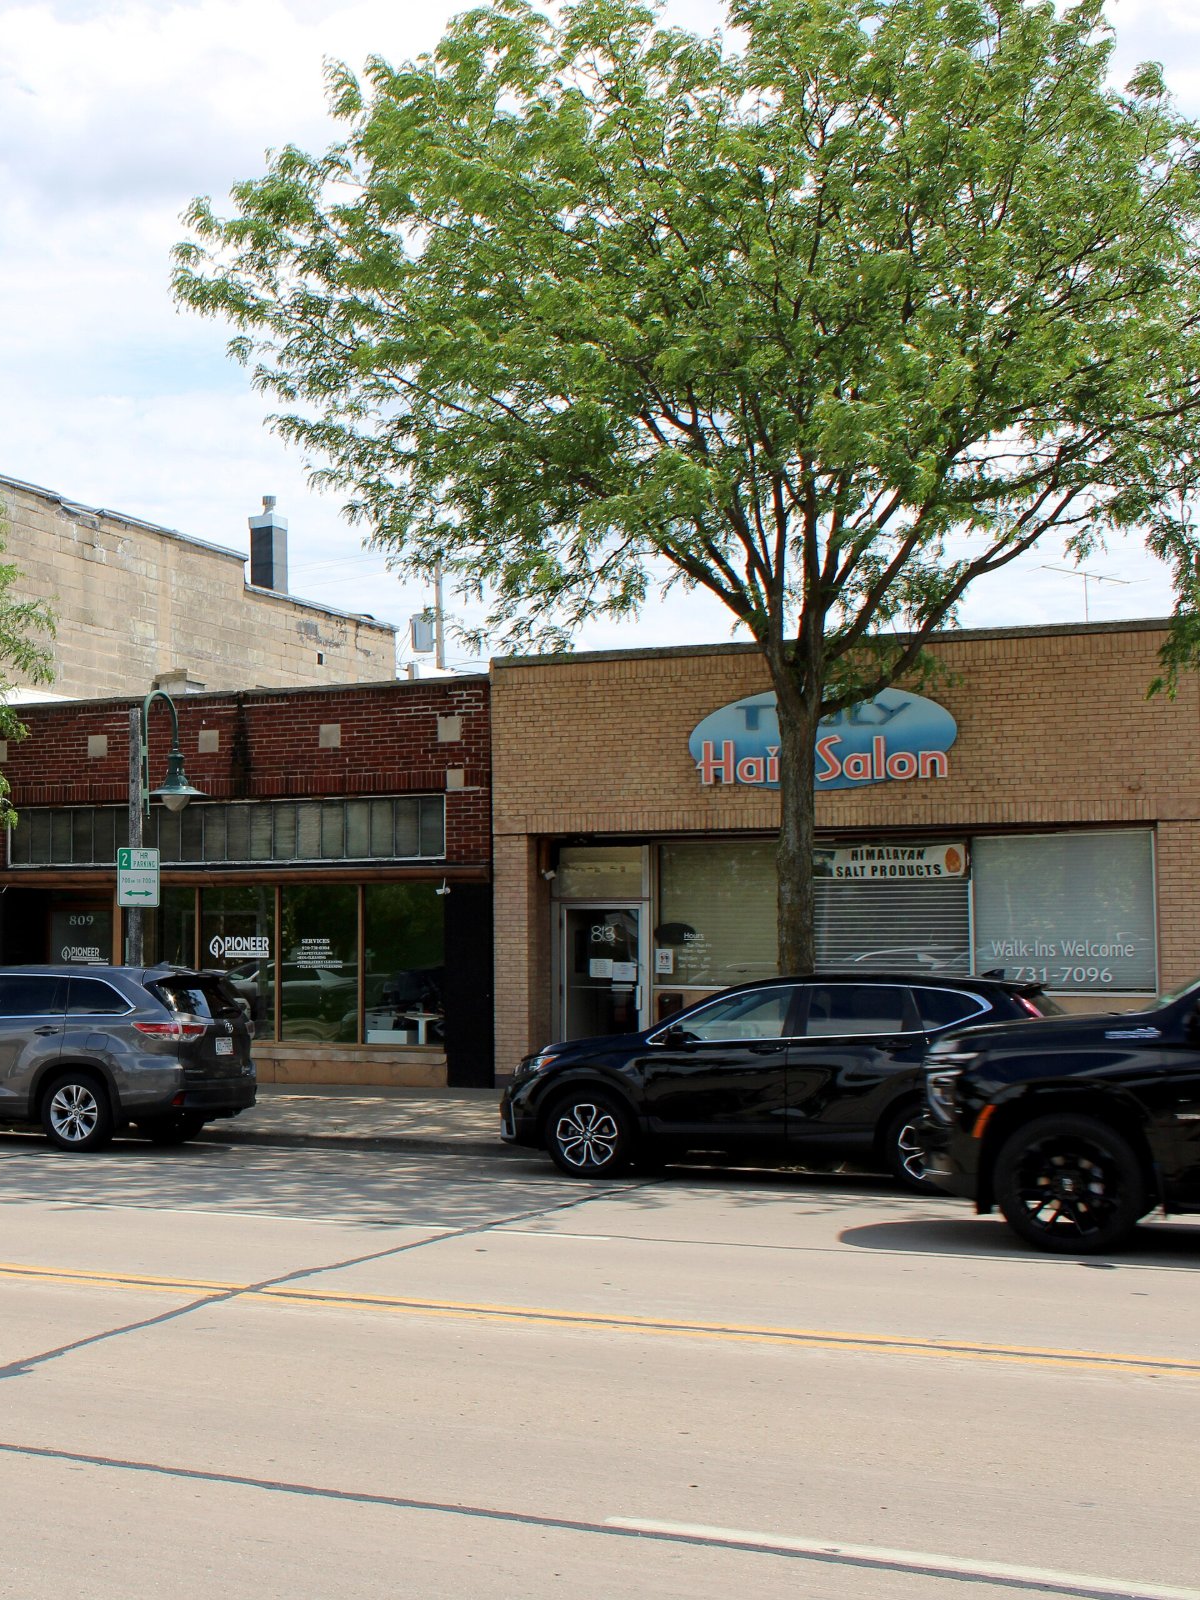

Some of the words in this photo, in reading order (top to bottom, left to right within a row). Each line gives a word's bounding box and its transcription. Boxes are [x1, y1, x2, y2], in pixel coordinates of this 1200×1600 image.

[696, 739, 780, 785] Hai
[815, 735, 948, 782] Salon
[121, 852, 128, 866] 2
[851, 848, 925, 861] HIMALAYAN
[133, 860, 156, 868] PARKING
[836, 865, 865, 877] SALT
[871, 864, 941, 876] PRODUCTS
[69, 915, 94, 926] 809
[591, 925, 616, 942] 813
[683, 932, 705, 941] Hours
[224, 936, 270, 951] PIONEER
[991, 940, 1056, 957] Walk-Ins
[1061, 940, 1135, 957] Welcome
[70, 946, 100, 957] PIONEER
[1012, 967, 1113, 983] 731-7096
